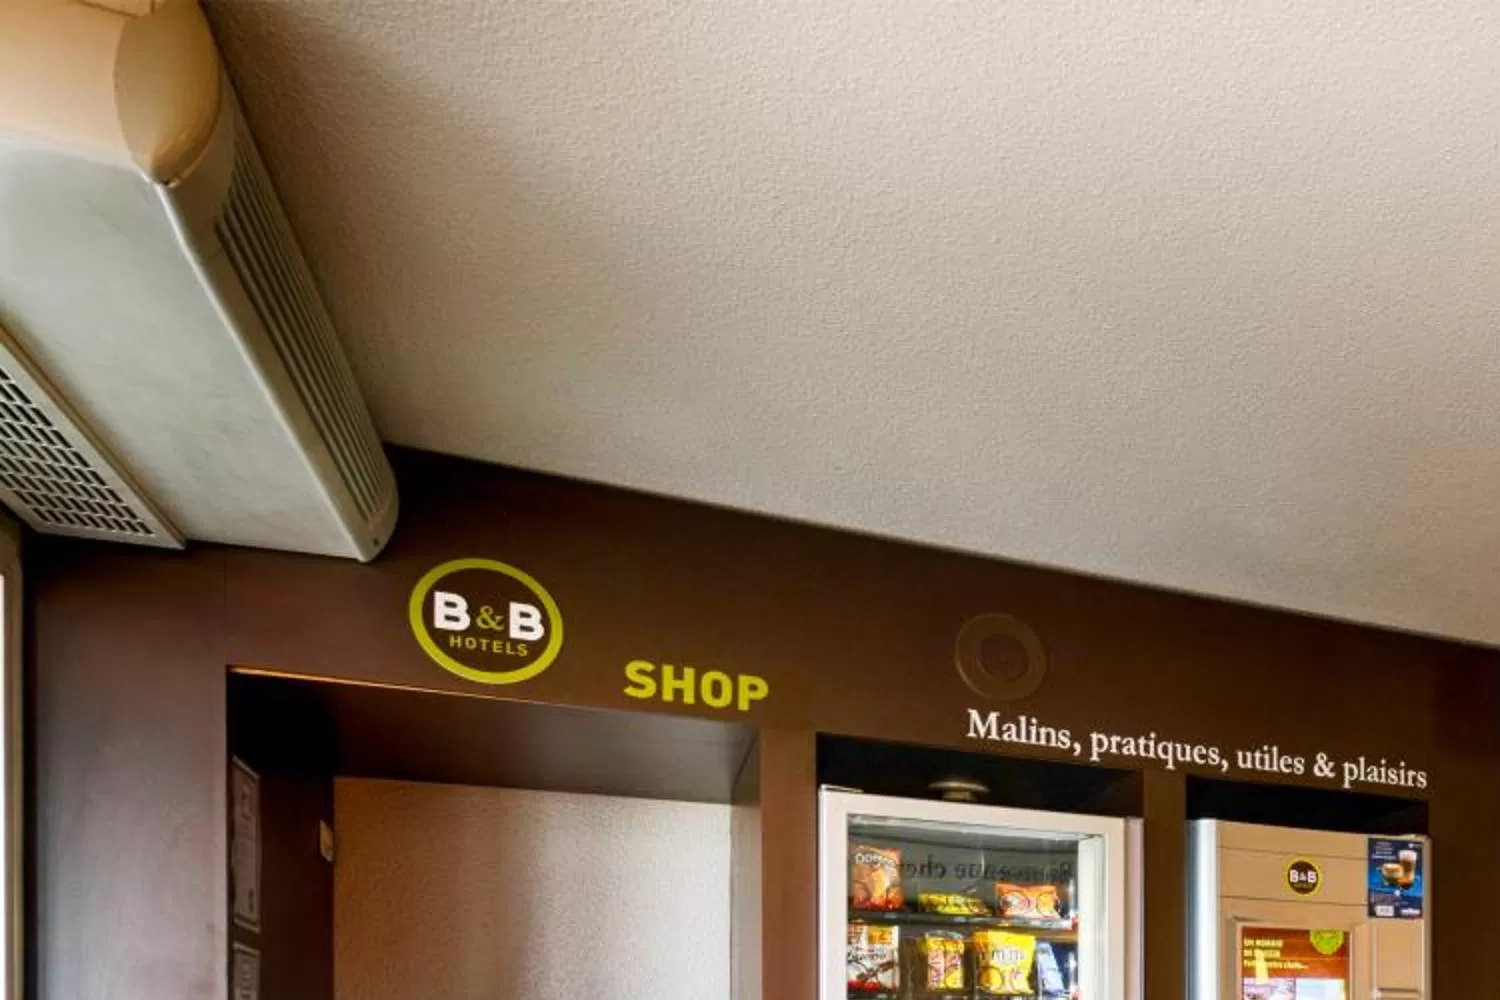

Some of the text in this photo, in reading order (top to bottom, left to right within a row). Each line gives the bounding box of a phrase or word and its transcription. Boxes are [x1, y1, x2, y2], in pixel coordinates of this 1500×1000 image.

[433, 590, 545, 642] B&B
[449, 634, 529, 658] HOTELS
[623, 659, 770, 712] SHOP
[966, 708, 1428, 789] Malins, pratiques, utiles & plaisirs
